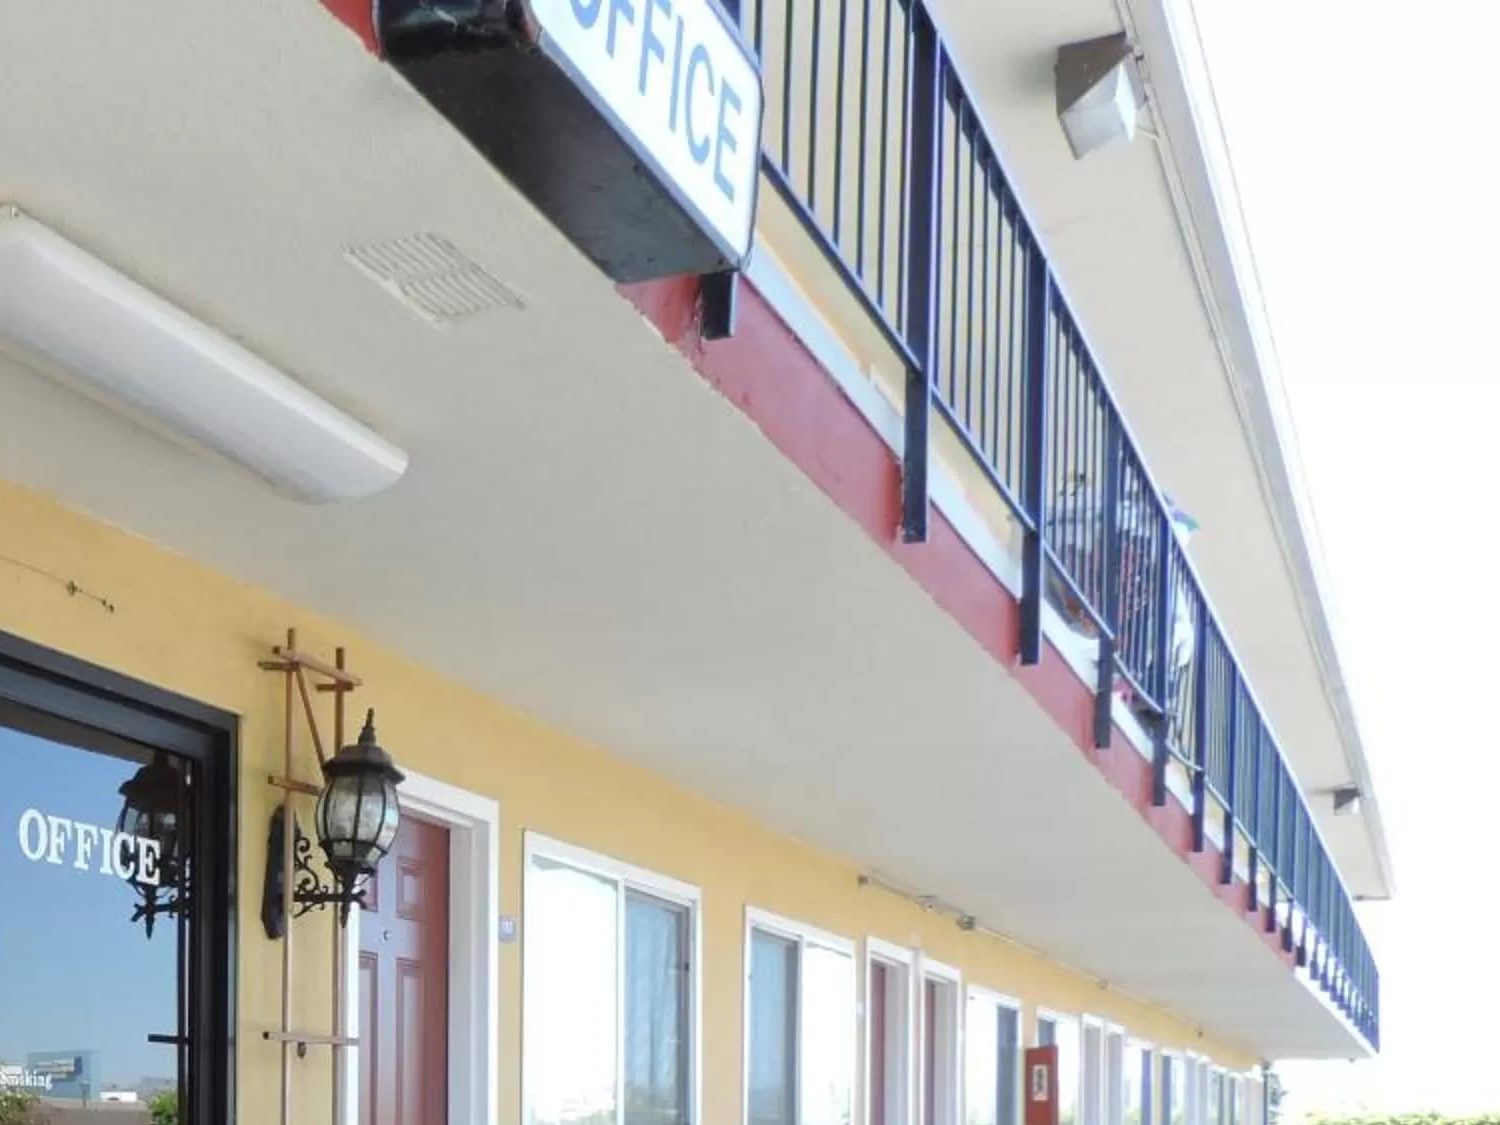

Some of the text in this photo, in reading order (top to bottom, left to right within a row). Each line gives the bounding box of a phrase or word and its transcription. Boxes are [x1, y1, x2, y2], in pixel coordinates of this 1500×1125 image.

[571, 0, 741, 203] FFICE
[19, 808, 161, 885] OFFICE
[0, 1069, 53, 1091] Smoking
